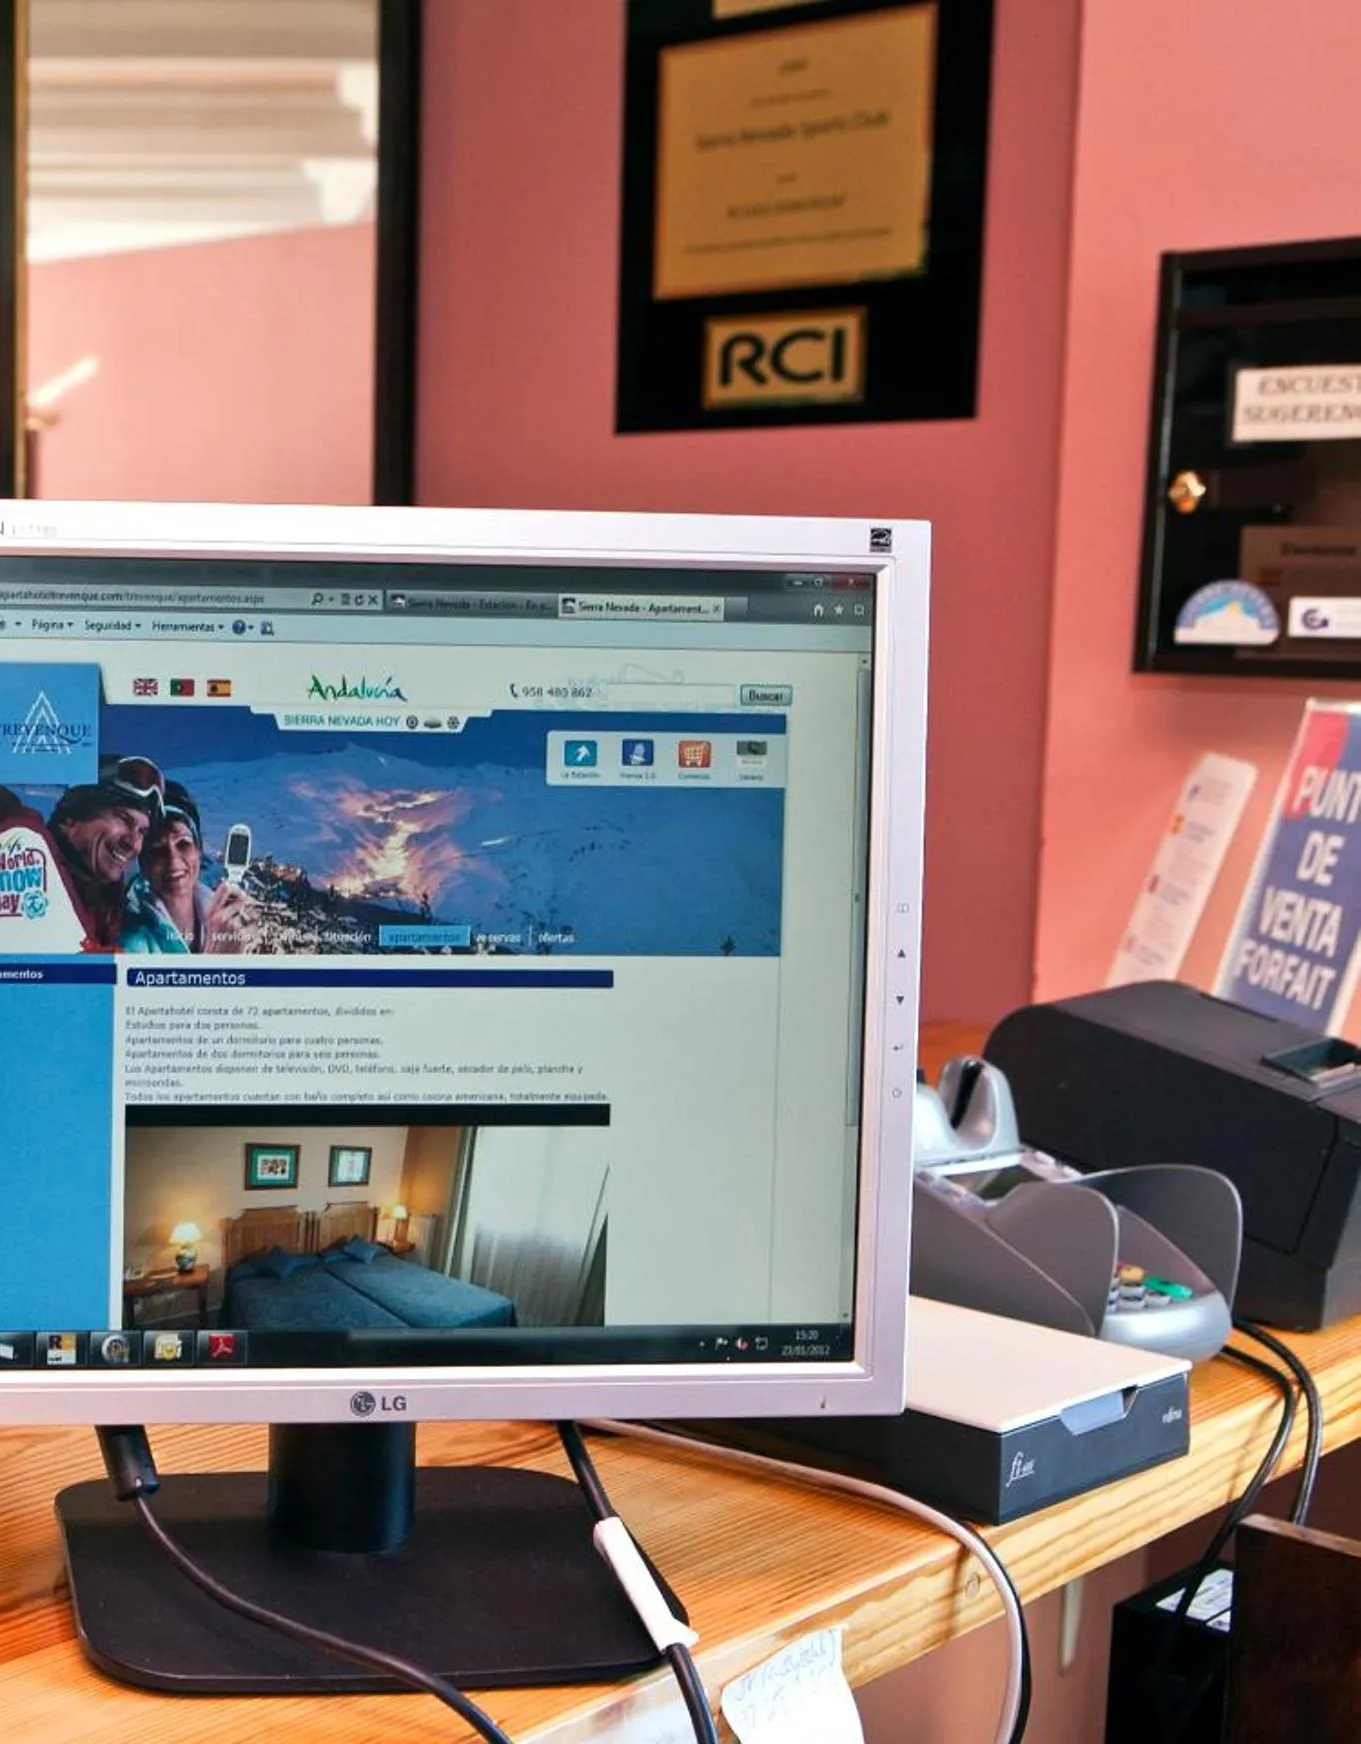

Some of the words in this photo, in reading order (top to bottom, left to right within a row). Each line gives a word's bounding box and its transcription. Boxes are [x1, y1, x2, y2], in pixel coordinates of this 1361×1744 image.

[718, 327, 846, 388] RCI
[579, 602, 603, 612] Sierra
[606, 602, 639, 613] Nevada
[32, 619, 64, 631] Página
[84, 620, 132, 632] Seguridad
[152, 622, 215, 633] Herramientas
[308, 675, 409, 701] Andalucía
[749, 690, 783, 702] Buscar
[284, 714, 325, 726] SIERRA
[328, 715, 373, 727] NEVADA
[375, 716, 400, 727] HOY
[1296, 830, 1345, 887] DE
[1259, 885, 1343, 958] VENTA
[538, 931, 575, 943] ofertas
[135, 971, 246, 986] Apartamentos
[1234, 937, 1337, 1011] FORFAIT
[231, 1006, 243, 1016] de
[169, 1021, 191, 1030] para
[125, 1035, 193, 1046] Apartamentos
[197, 1035, 208, 1046] de
[279, 1035, 301, 1046] para
[304, 1035, 334, 1046] cuatro
[125, 1049, 193, 1060] Apartamentos
[196, 1049, 208, 1060] de
[288, 1049, 310, 1060] para
[144, 1064, 212, 1075] Apartamentos
[261, 1064, 273, 1075] de
[497, 1064, 509, 1075] de
[795, 1330, 819, 1340] 15:20
[381, 1395, 407, 1411] LG
